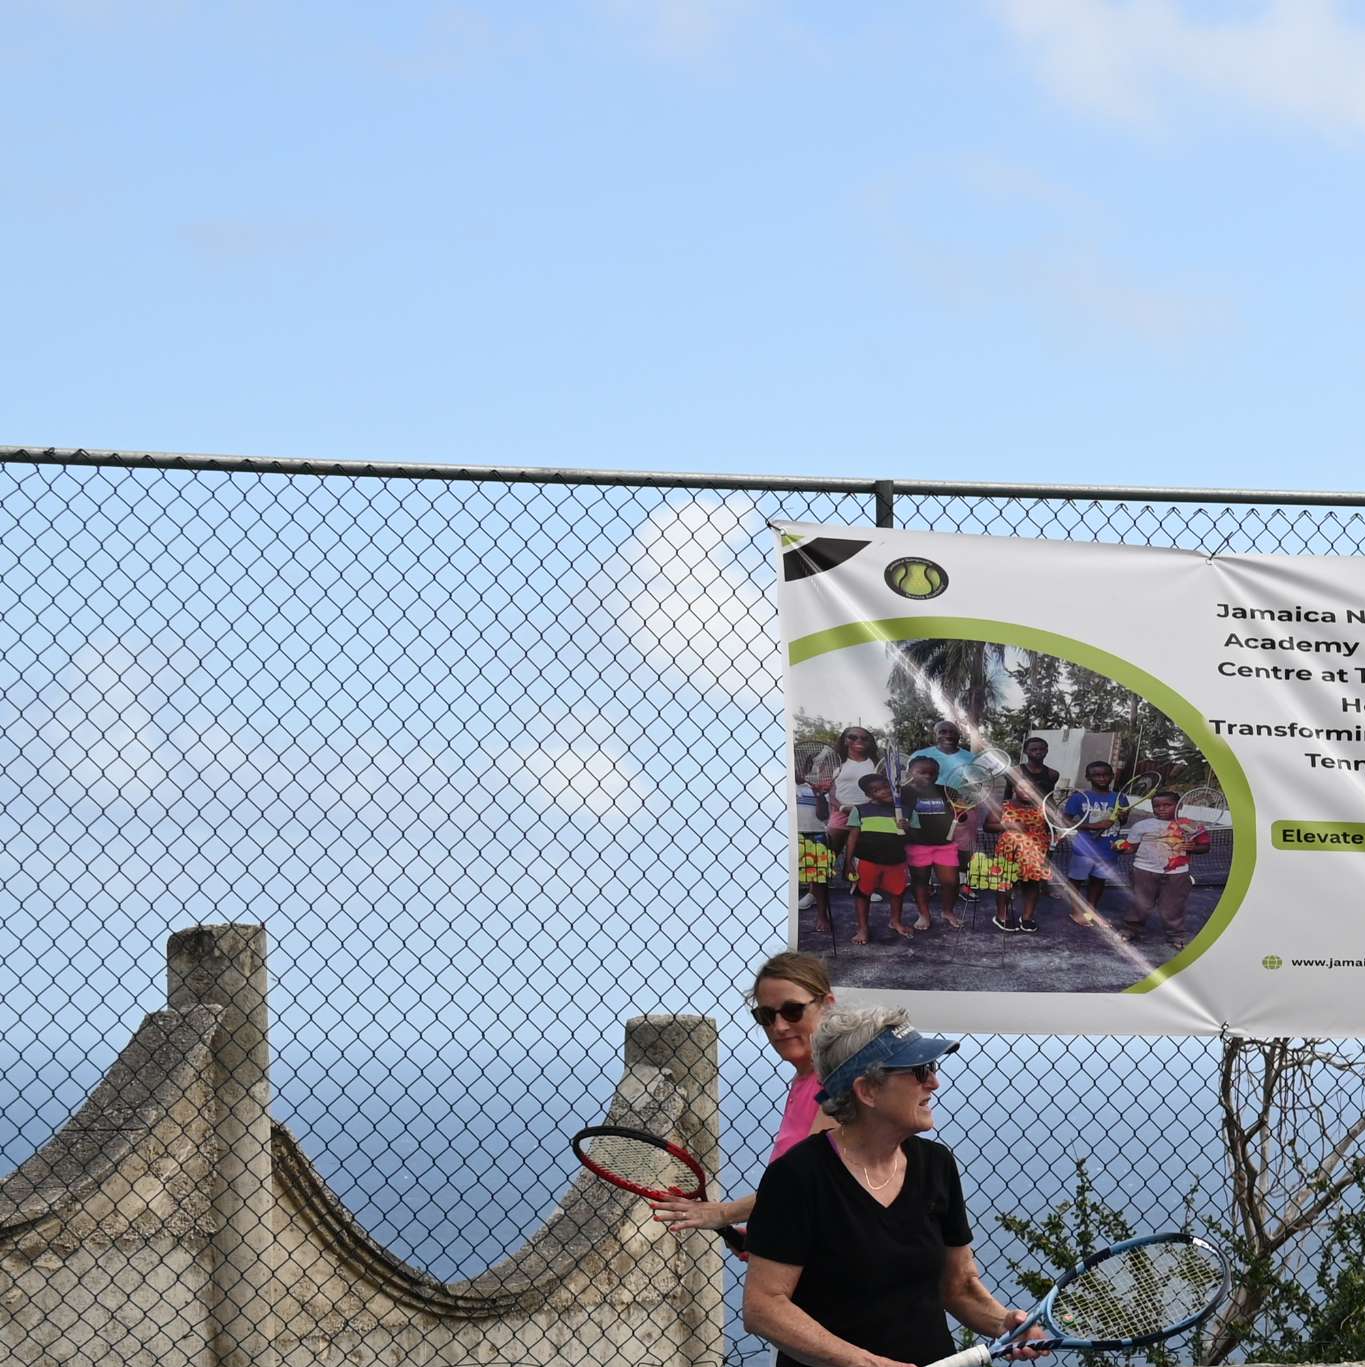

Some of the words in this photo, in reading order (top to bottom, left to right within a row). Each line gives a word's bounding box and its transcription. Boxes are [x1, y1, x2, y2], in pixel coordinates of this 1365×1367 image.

[1216, 603, 1336, 624] Jamaica
[1224, 632, 1359, 657] Academy
[1217, 661, 1313, 682] Centre
[1321, 668, 1348, 683] at
[1282, 828, 1364, 845] Elevate
